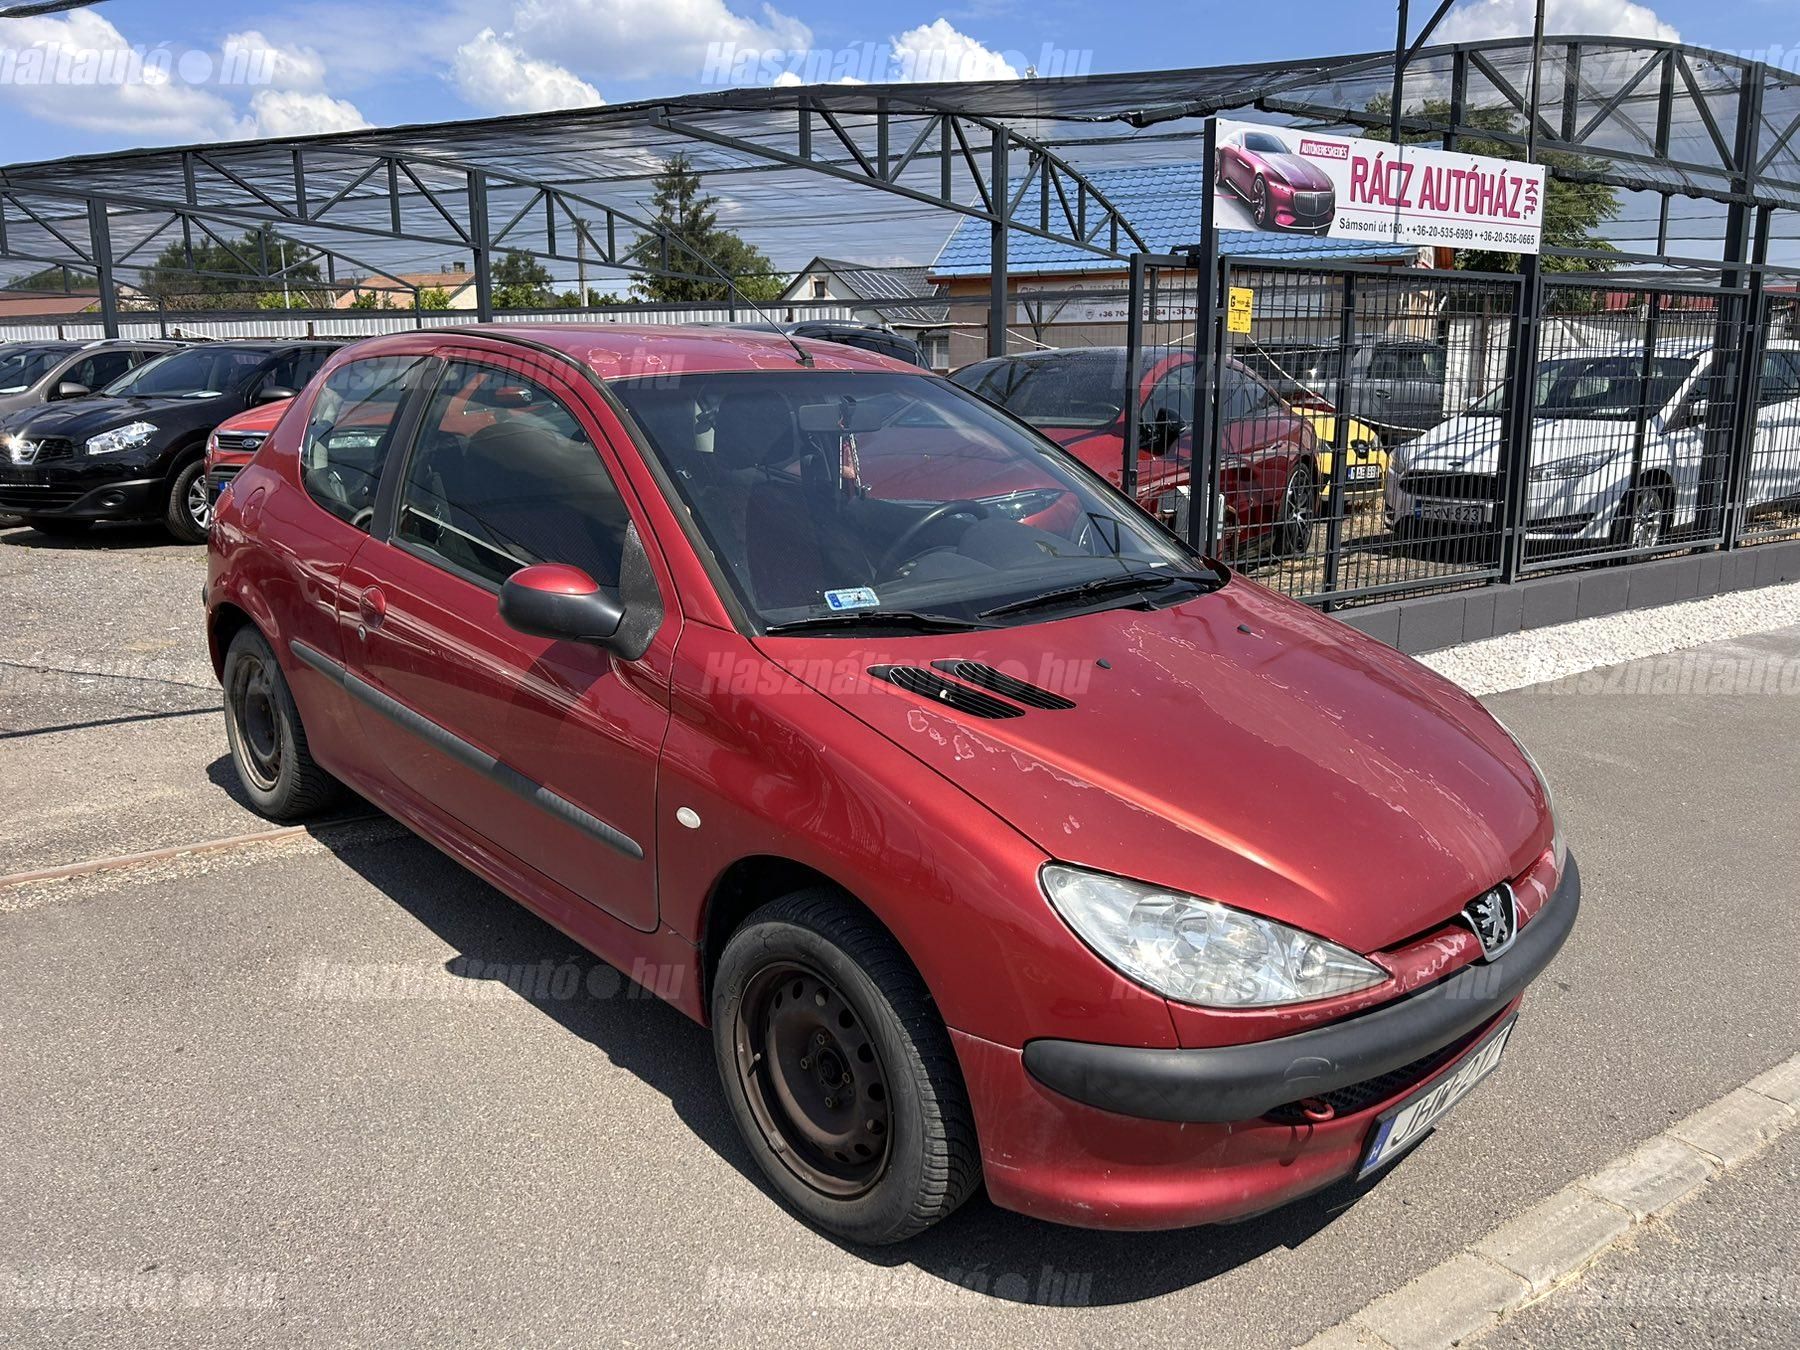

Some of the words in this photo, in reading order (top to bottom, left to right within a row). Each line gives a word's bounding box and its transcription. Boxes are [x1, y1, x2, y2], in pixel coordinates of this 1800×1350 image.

[1350, 151, 1414, 208] RÁCZ
[1418, 164, 1523, 218] AUTÓHÁZ
[1524, 178, 1539, 219] Kft.
[1339, 217, 1376, 232] Sámsoni
[1378, 221, 1386, 233] út
